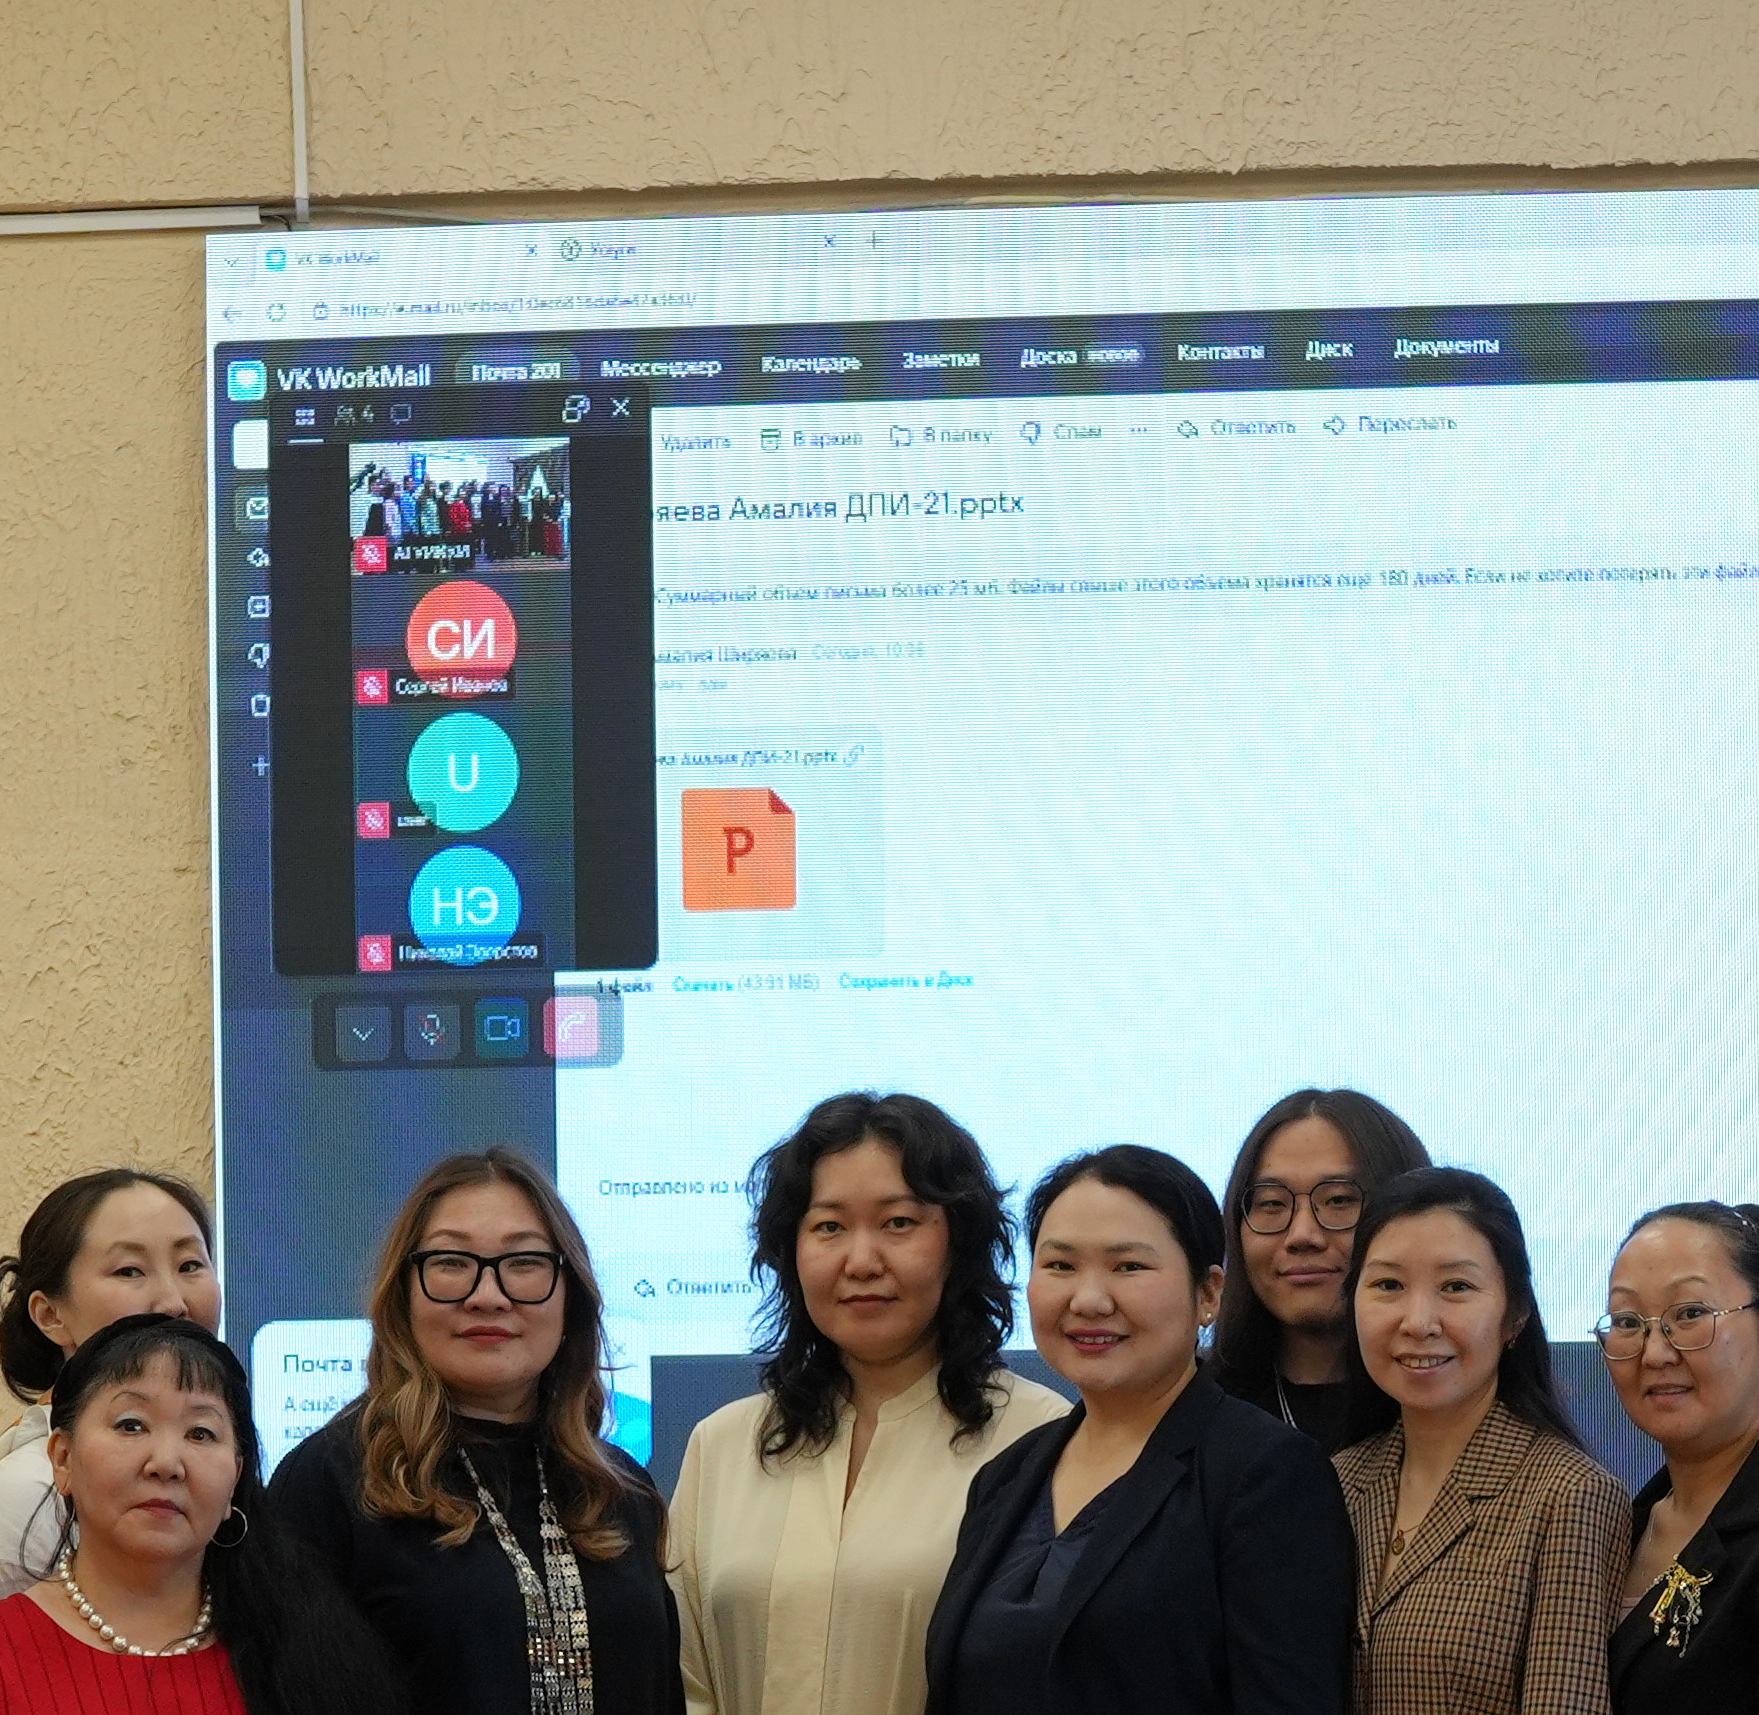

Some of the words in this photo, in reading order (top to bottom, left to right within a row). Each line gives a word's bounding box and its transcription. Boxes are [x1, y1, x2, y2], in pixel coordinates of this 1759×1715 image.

[1020, 347, 1078, 368] Доска
[1088, 347, 1140, 364] новое
[1177, 342, 1266, 362] Контакты
[1305, 340, 1353, 361] Диск
[1393, 337, 1500, 358] Документы
[600, 357, 722, 380] Мессенджер
[761, 354, 863, 377] Календарь
[902, 350, 981, 370] Заметки
[278, 367, 311, 392] VK
[316, 363, 431, 389] WorkMail
[471, 361, 527, 383] Почта
[1053, 421, 1103, 442] Спам
[1210, 417, 1297, 437] Ответить
[1357, 414, 1458, 436] Переслать
[661, 433, 733, 453] Удалить
[728, 497, 838, 522] Амалия
[844, 490, 1025, 524] ДПИ-21.pptx
[426, 618, 498, 661] СИ
[394, 676, 449, 697] Сергей
[451, 675, 510, 694] Иванов
[447, 752, 480, 794] U
[722, 824, 756, 877] P
[430, 885, 500, 926] НЭ
[598, 1178, 706, 1198] Отправлено
[666, 1277, 753, 1296] Ответить
[283, 1352, 354, 1374] Почта
